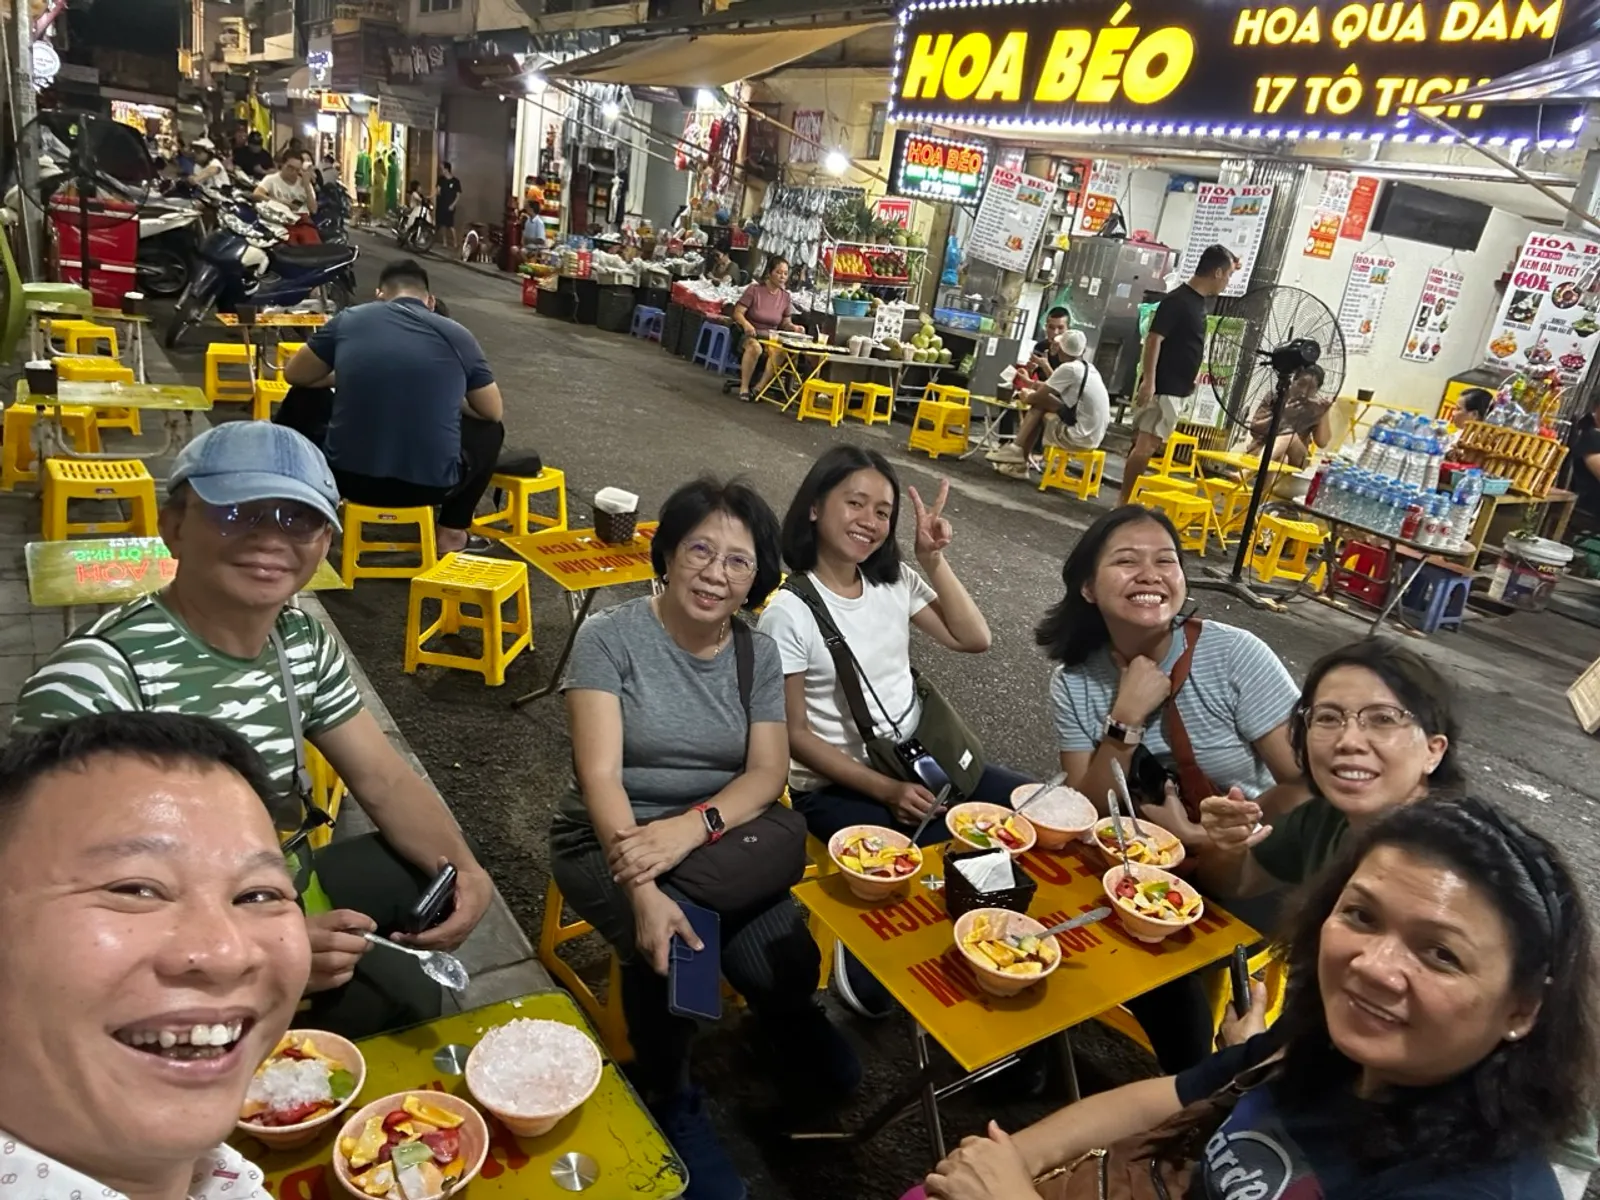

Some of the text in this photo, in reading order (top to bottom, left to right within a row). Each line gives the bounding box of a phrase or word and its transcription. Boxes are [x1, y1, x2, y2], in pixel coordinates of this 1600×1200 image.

[1233, 7, 1320, 45] HOA
[902, 2, 1194, 104] HOA BÉO
[1253, 77, 1297, 114] 17
[1304, 63, 1363, 115] TÔ
[907, 141, 982, 174] HOA BÉO
[995, 169, 1023, 184] HOA
[1200, 185, 1271, 196] HOA BÉO
[1530, 237, 1576, 252] HOA
[1356, 256, 1375, 267] HOA
[1520, 259, 1539, 271] KEM
[1431, 268, 1448, 278] HOA
[1205, 1132, 1264, 1193] ard
